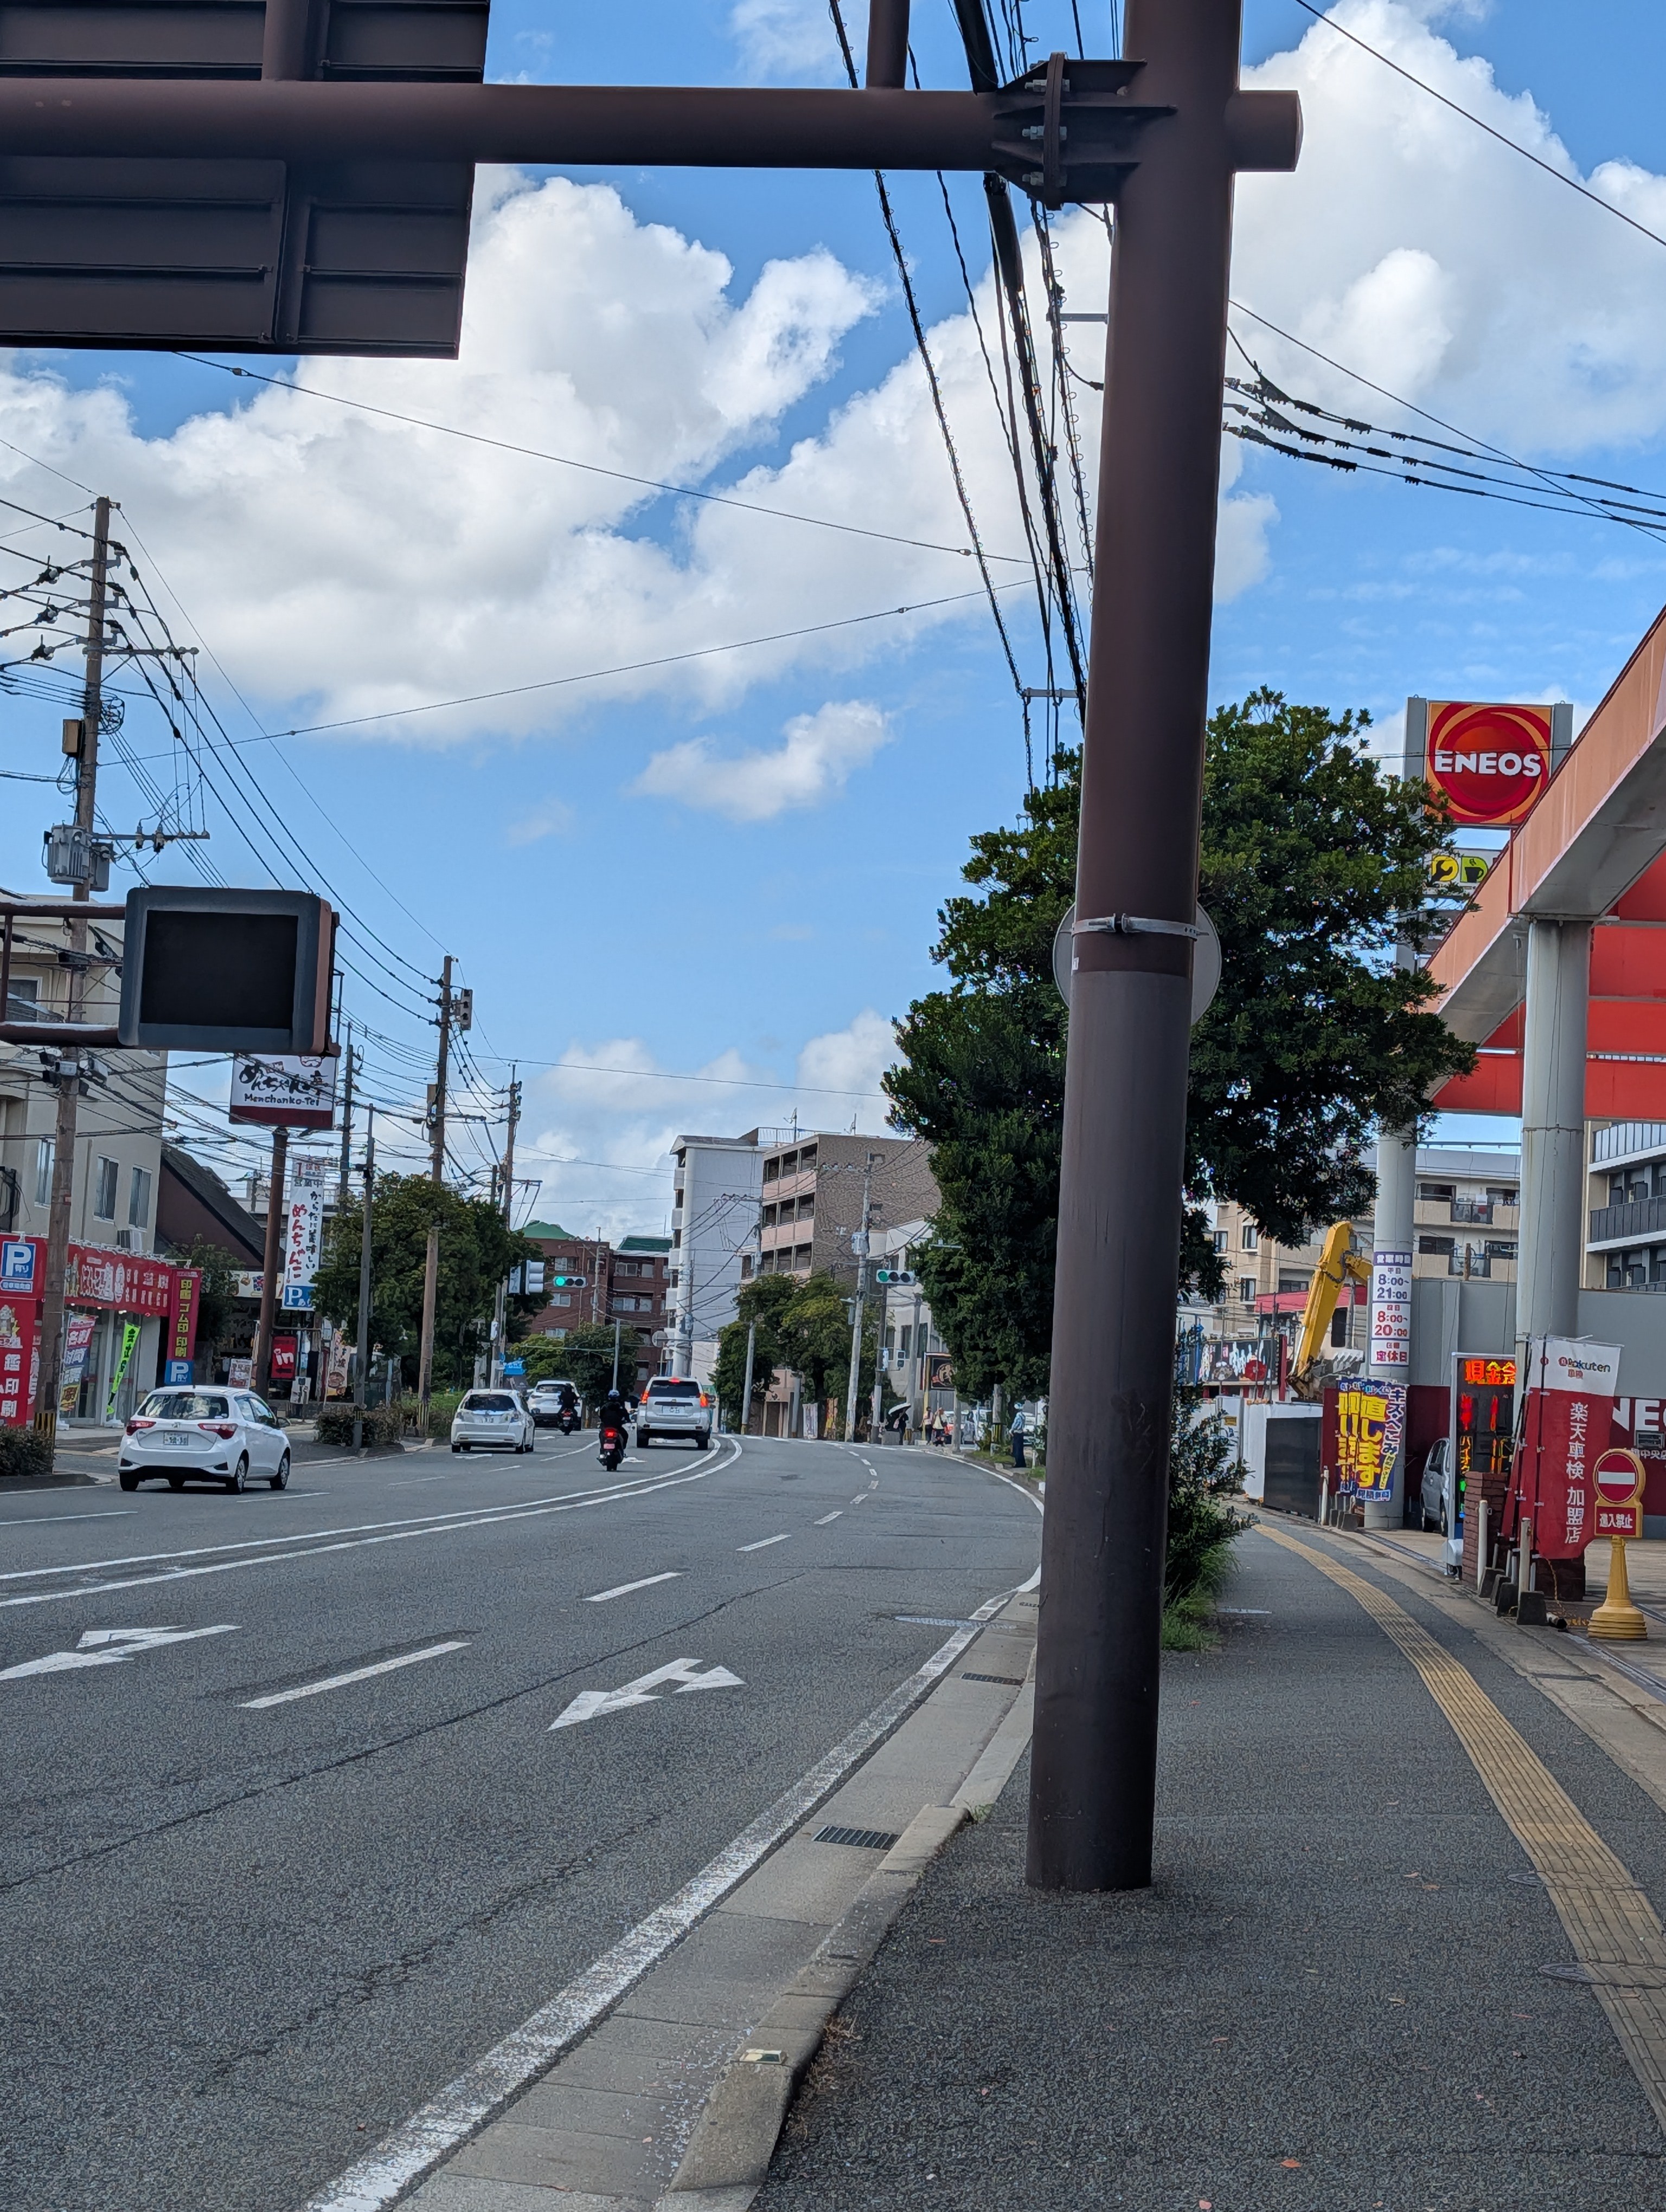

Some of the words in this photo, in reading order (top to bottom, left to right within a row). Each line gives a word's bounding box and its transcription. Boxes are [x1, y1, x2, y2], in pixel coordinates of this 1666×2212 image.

[1434, 749, 1541, 777] ENEOS
[244, 1093, 320, 1106] Menchanko-Tei
[289, 1204, 307, 1278] めんちゃんこ
[5, 1244, 31, 1276] P
[286, 1287, 303, 1306] P
[1377, 1287, 1407, 1300] 21:00
[1374, 1324, 1407, 1337] 20:00
[1376, 1351, 1407, 1362] 定休日
[1568, 1358, 1611, 1373] Rakuten
[170, 1362, 189, 1382] P
[1566, 1401, 1588, 1480] 楽天車検
[1564, 1486, 1585, 1544] 加盟店
